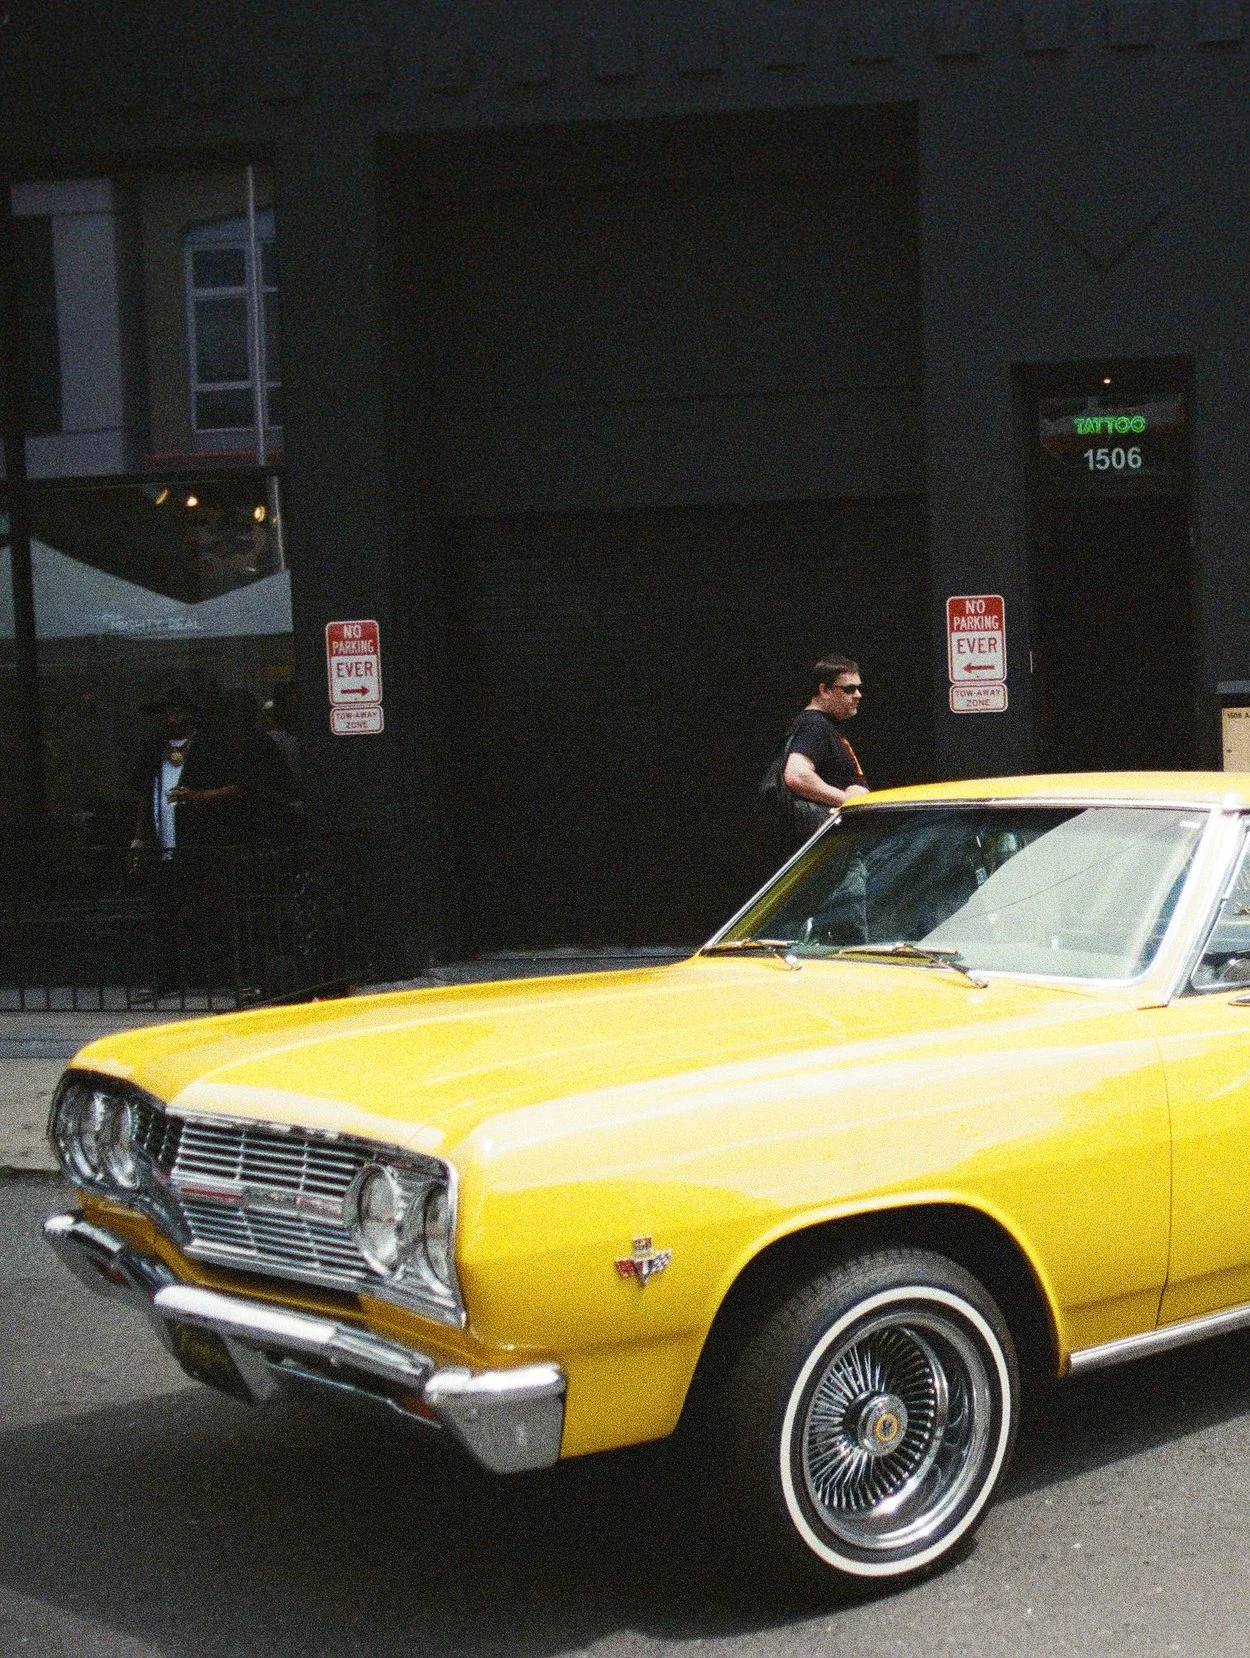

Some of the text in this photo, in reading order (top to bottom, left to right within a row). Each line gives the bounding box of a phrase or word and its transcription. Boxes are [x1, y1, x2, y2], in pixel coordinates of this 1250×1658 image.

[1074, 415, 1146, 435] TATTOO
[1083, 447, 1143, 471] 1506
[965, 599, 986, 614] NO
[953, 615, 999, 630] PARKING
[343, 624, 362, 639] NO
[332, 640, 374, 655] PARKING
[957, 638, 998, 654] EVER
[336, 661, 373, 678] EVER
[955, 689, 1001, 697] TOW-AWAY
[966, 698, 991, 707] ZONE
[336, 711, 377, 719] TOW-AWAY
[345, 721, 368, 729] ZONE
